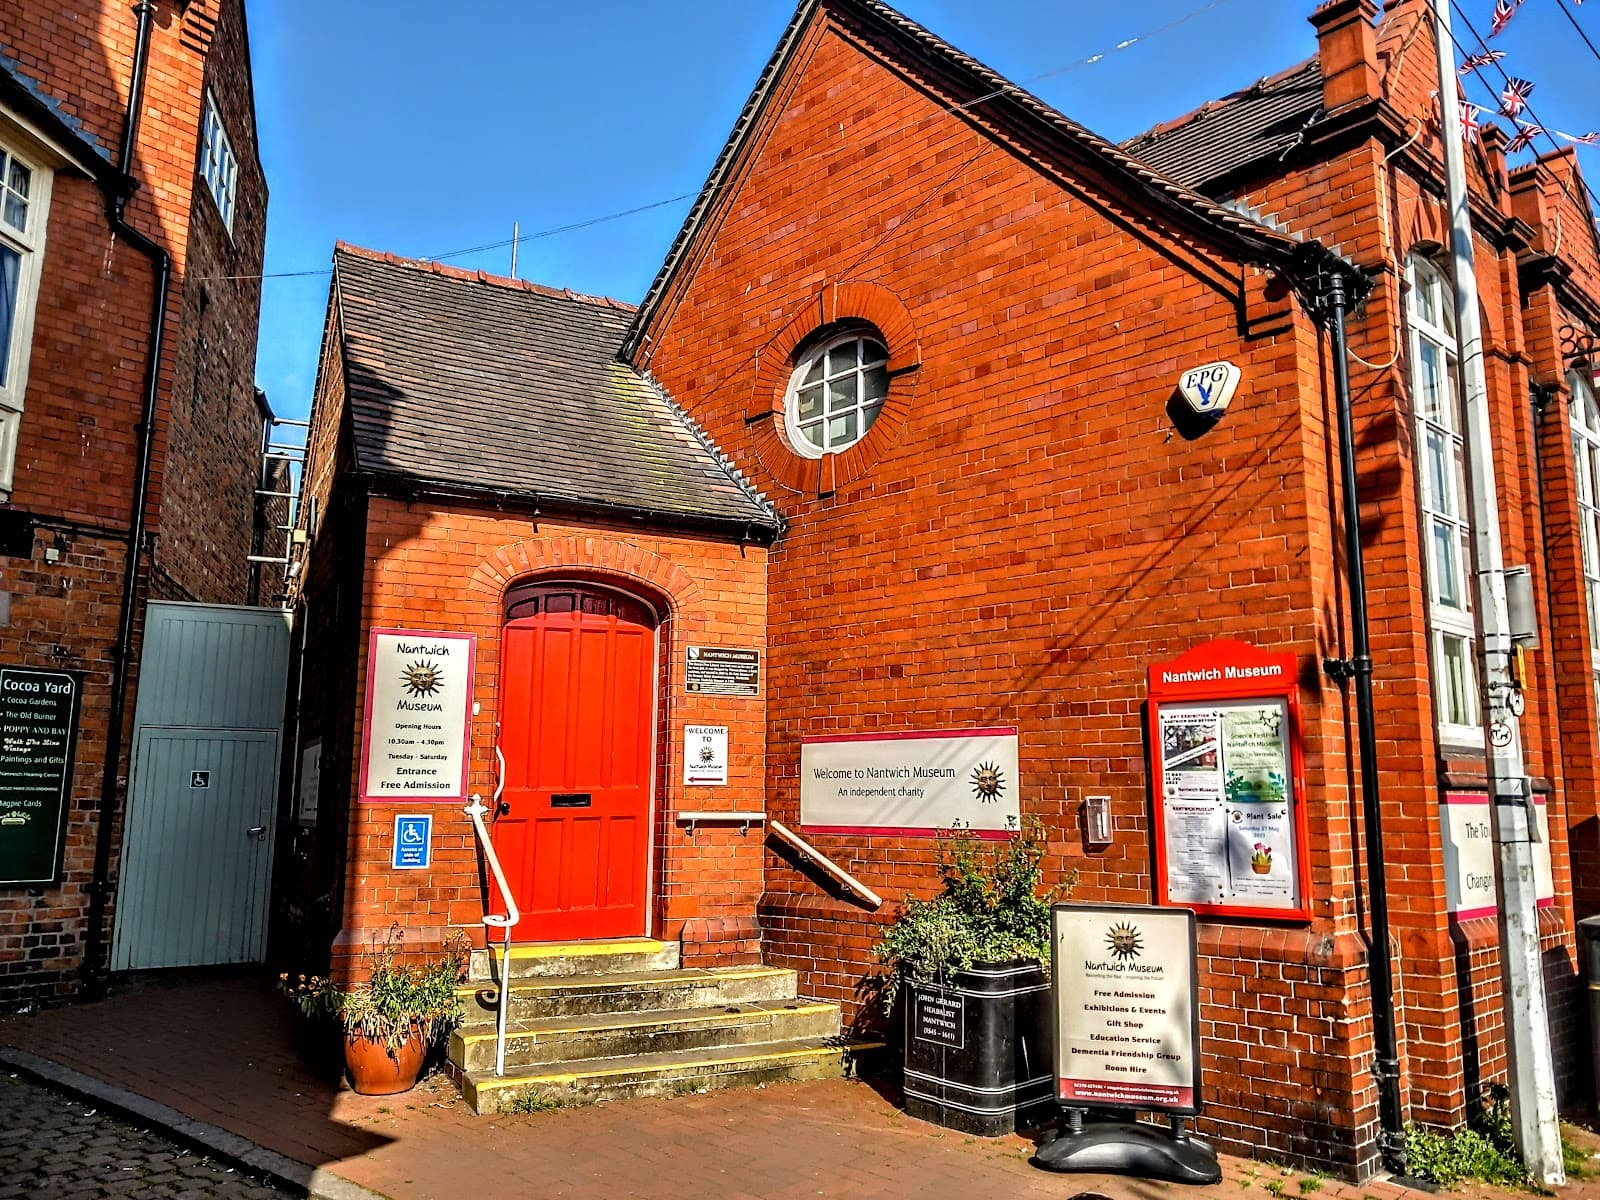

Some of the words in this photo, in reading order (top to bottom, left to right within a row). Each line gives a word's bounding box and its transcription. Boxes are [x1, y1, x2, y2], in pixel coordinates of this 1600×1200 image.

[1186, 367, 1223, 388] EPG
[396, 642, 450, 656] Nantwich
[1162, 668, 1221, 684] Nantwich
[1225, 665, 1282, 679] Museum
[4, 679, 40, 692] Cocoa
[44, 682, 71, 694] Yard
[7, 696, 28, 704] Cocoa
[29, 698, 57, 706] Gardens
[396, 700, 442, 712] Museum
[4, 725, 30, 734] POPPY
[0, 755, 33, 764] Paintings
[814, 768, 852, 779] Welcome
[854, 768, 864, 779] to
[866, 767, 910, 779] Nantwich
[912, 766, 955, 778] Museum
[404, 781, 450, 790] Admission
[838, 787, 848, 796] An
[850, 786, 896, 798] independent
[898, 787, 924, 798] charity
[1465, 822, 1479, 838] The
[1479, 822, 1492, 838] To
[1466, 872, 1494, 892] Changin
[1085, 960, 1126, 972] Nantwich
[1128, 962, 1164, 973] Museum
[918, 994, 934, 1002] JOHN
[936, 998, 961, 1008] GERARD
[1114, 990, 1155, 999] Admission
[1084, 1004, 1129, 1013] Exhibitions
[922, 1016, 956, 1029] NANTWICH
[1124, 1021, 1144, 1029] Shop
[1090, 1034, 1130, 1042] Education
[1072, 1048, 1109, 1056] Dementia
[1111, 1050, 1154, 1060] Friendship
[1156, 1052, 1181, 1061] Group
[1074, 1090, 1178, 1103] www.nantwichmuseum.org.uk
